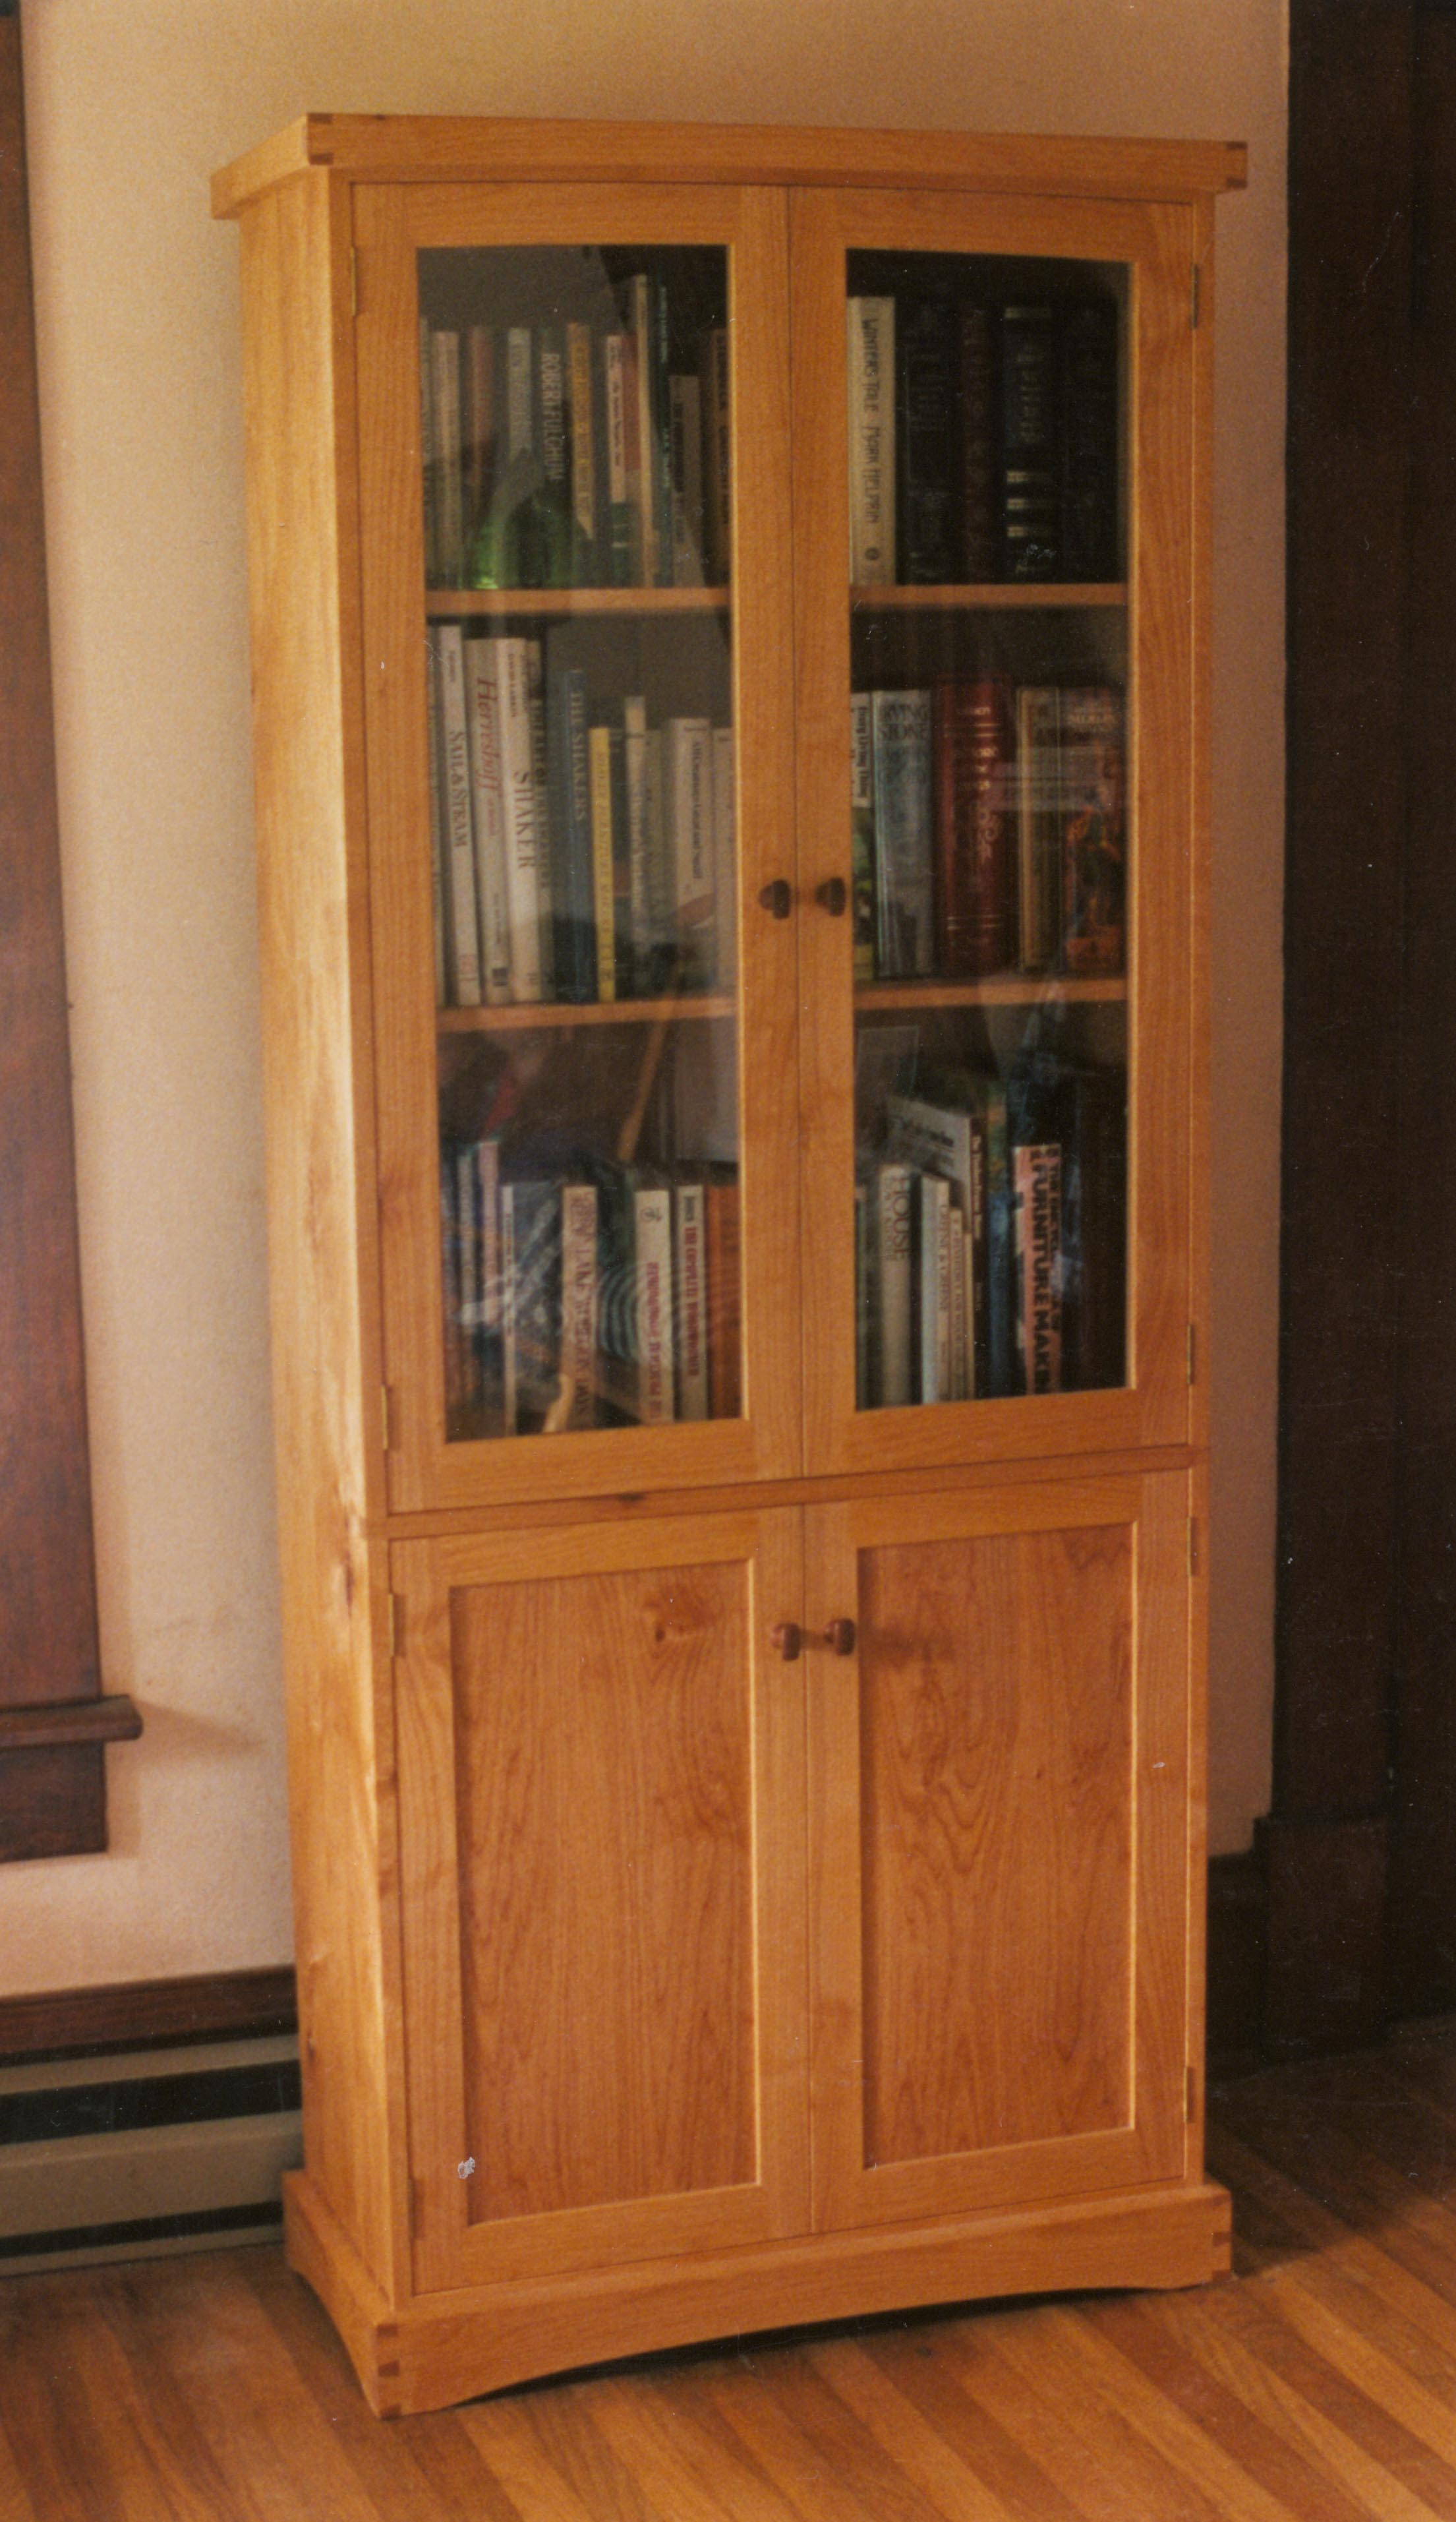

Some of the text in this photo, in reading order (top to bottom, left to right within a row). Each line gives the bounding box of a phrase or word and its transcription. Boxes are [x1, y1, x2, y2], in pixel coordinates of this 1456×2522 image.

[541, 353, 565, 480] ROBERT FULGHUM
[862, 380, 880, 413] TALE
[862, 426, 880, 464] MARK
[862, 468, 881, 524] HELPRIN
[449, 731, 469, 848] SAIL & STEAM
[475, 677, 502, 798] Herreshoff
[570, 692, 587, 822] THE SHAKERS
[513, 771, 535, 870] SHAKER
[892, 1177, 910, 1261] HOUSE
[1032, 1164, 1051, 1306] FURNITURE
